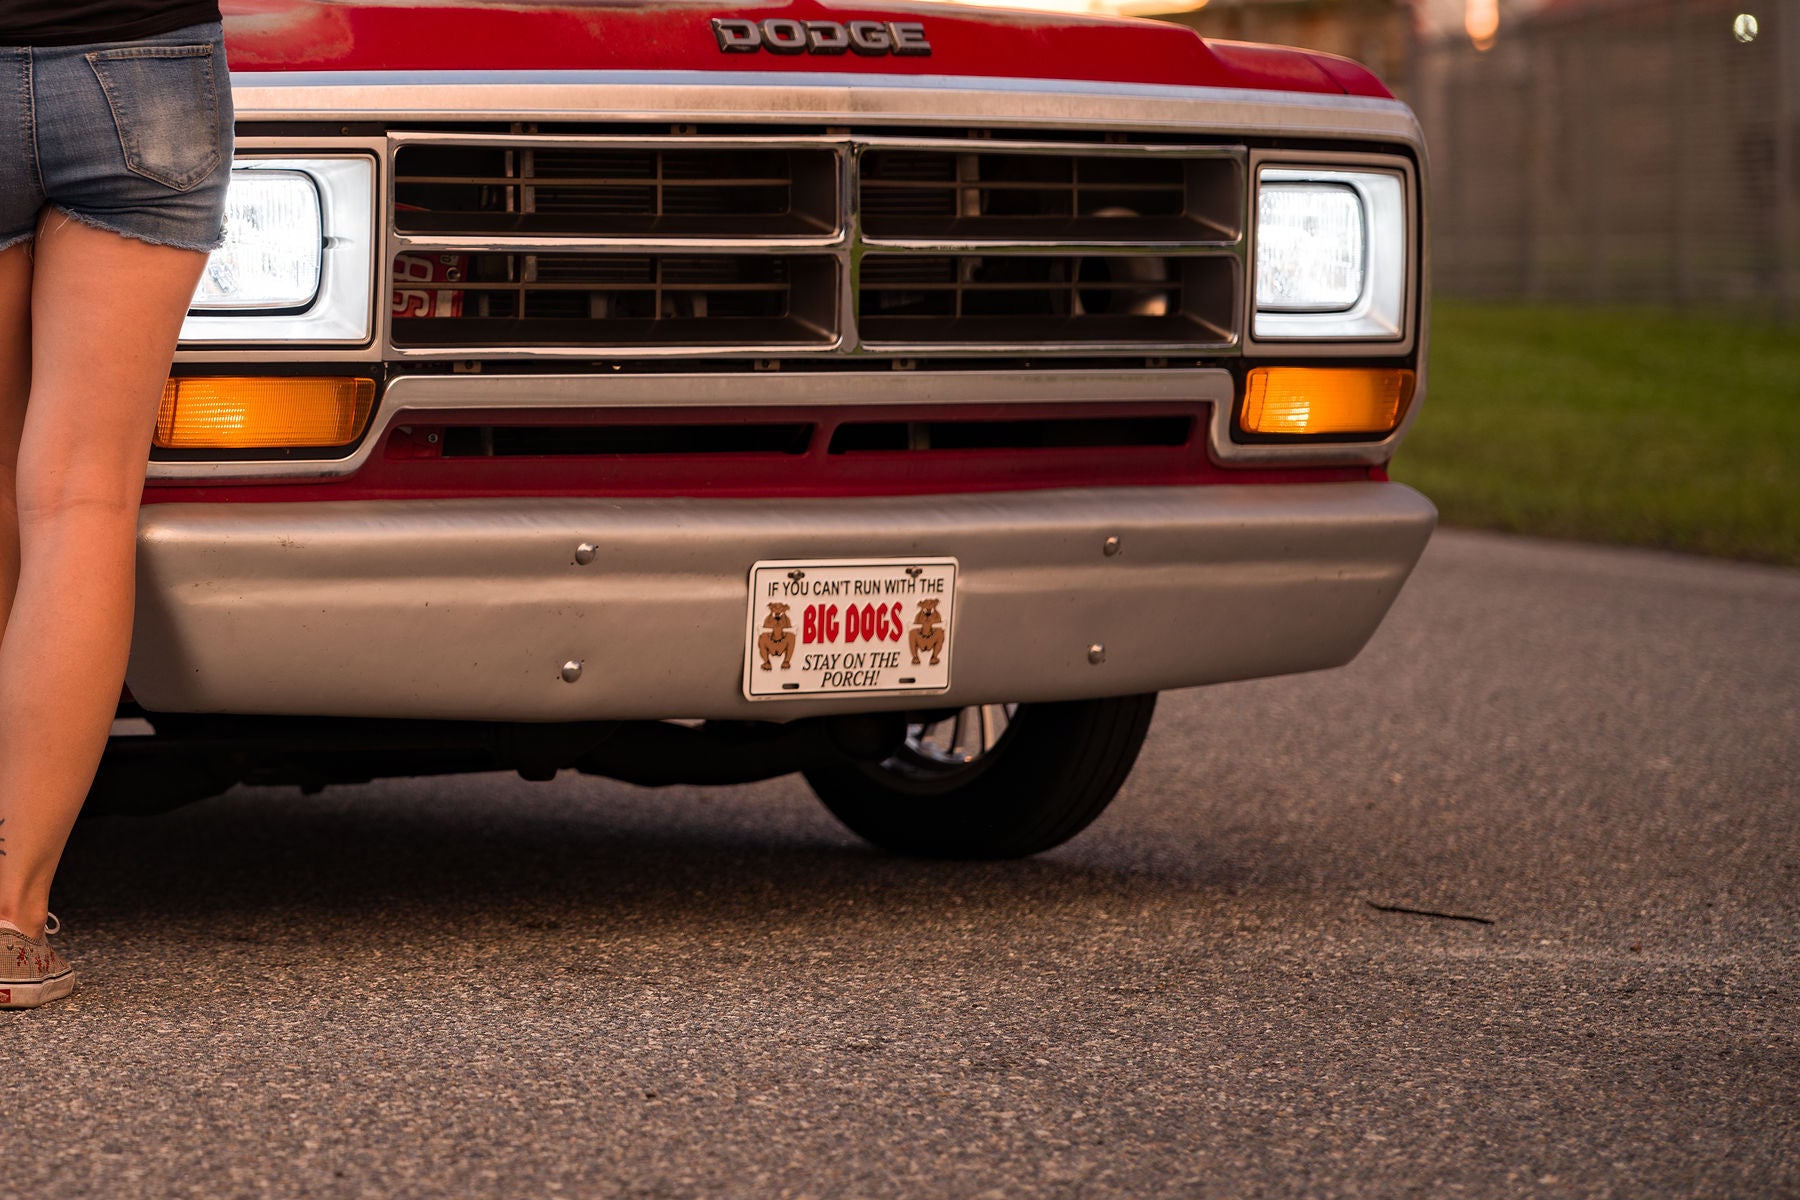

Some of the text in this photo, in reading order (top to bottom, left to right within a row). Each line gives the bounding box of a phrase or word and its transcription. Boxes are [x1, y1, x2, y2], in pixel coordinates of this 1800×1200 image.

[711, 17, 933, 57] DODGE
[768, 578, 944, 597] IF YOU CAN'T RUN WITH THE
[802, 601, 903, 644] BIG DOGS
[802, 651, 901, 671] STAY ON THE
[821, 670, 881, 688] PORCH!
